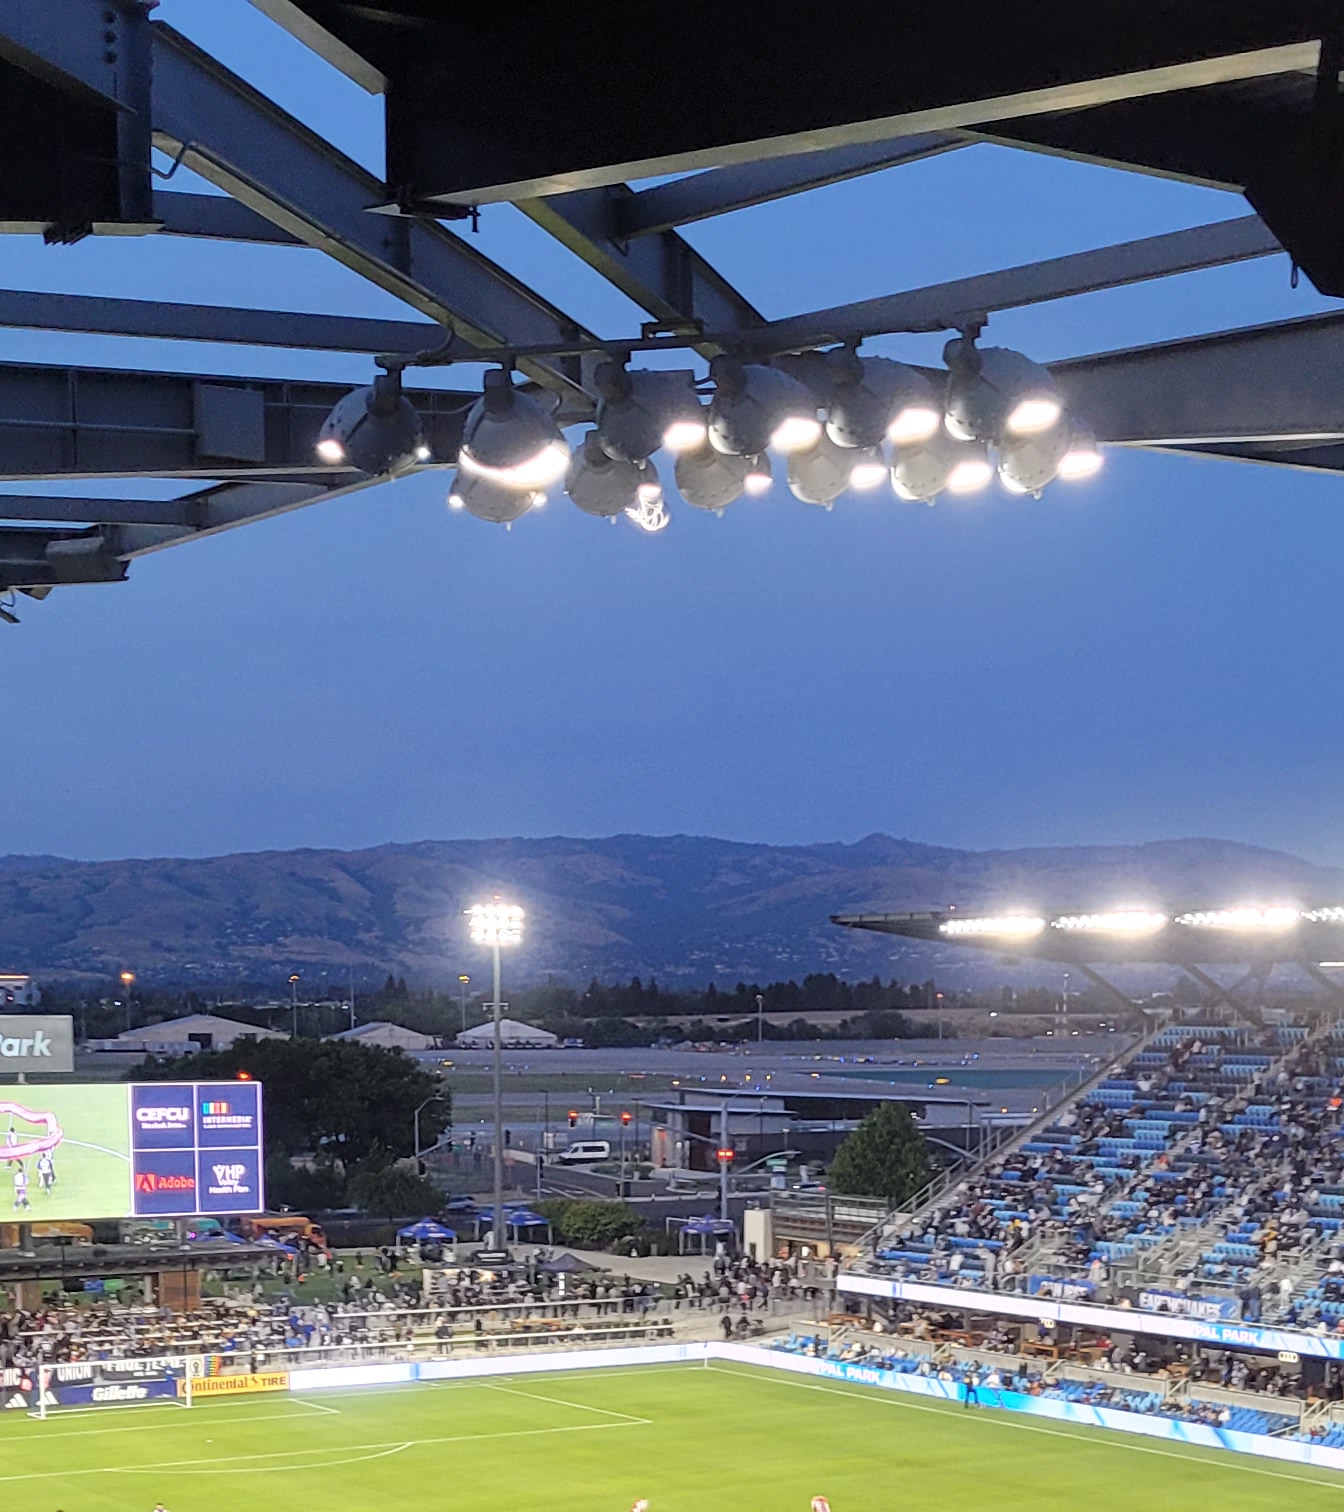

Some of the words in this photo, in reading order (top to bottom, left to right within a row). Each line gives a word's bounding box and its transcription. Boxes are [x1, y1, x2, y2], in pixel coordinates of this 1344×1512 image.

[136, 1107, 190, 1121] CEFCU
[212, 1164, 246, 1181] VHP
[158, 1176, 196, 1189] Adobe
[209, 1186, 233, 1194] Health
[1222, 1328, 1258, 1345] PARK
[56, 1364, 91, 1382] UNION
[261, 1376, 287, 1387] TIRE
[846, 1367, 880, 1384] PARK
[92, 1384, 148, 1402] Gillette
